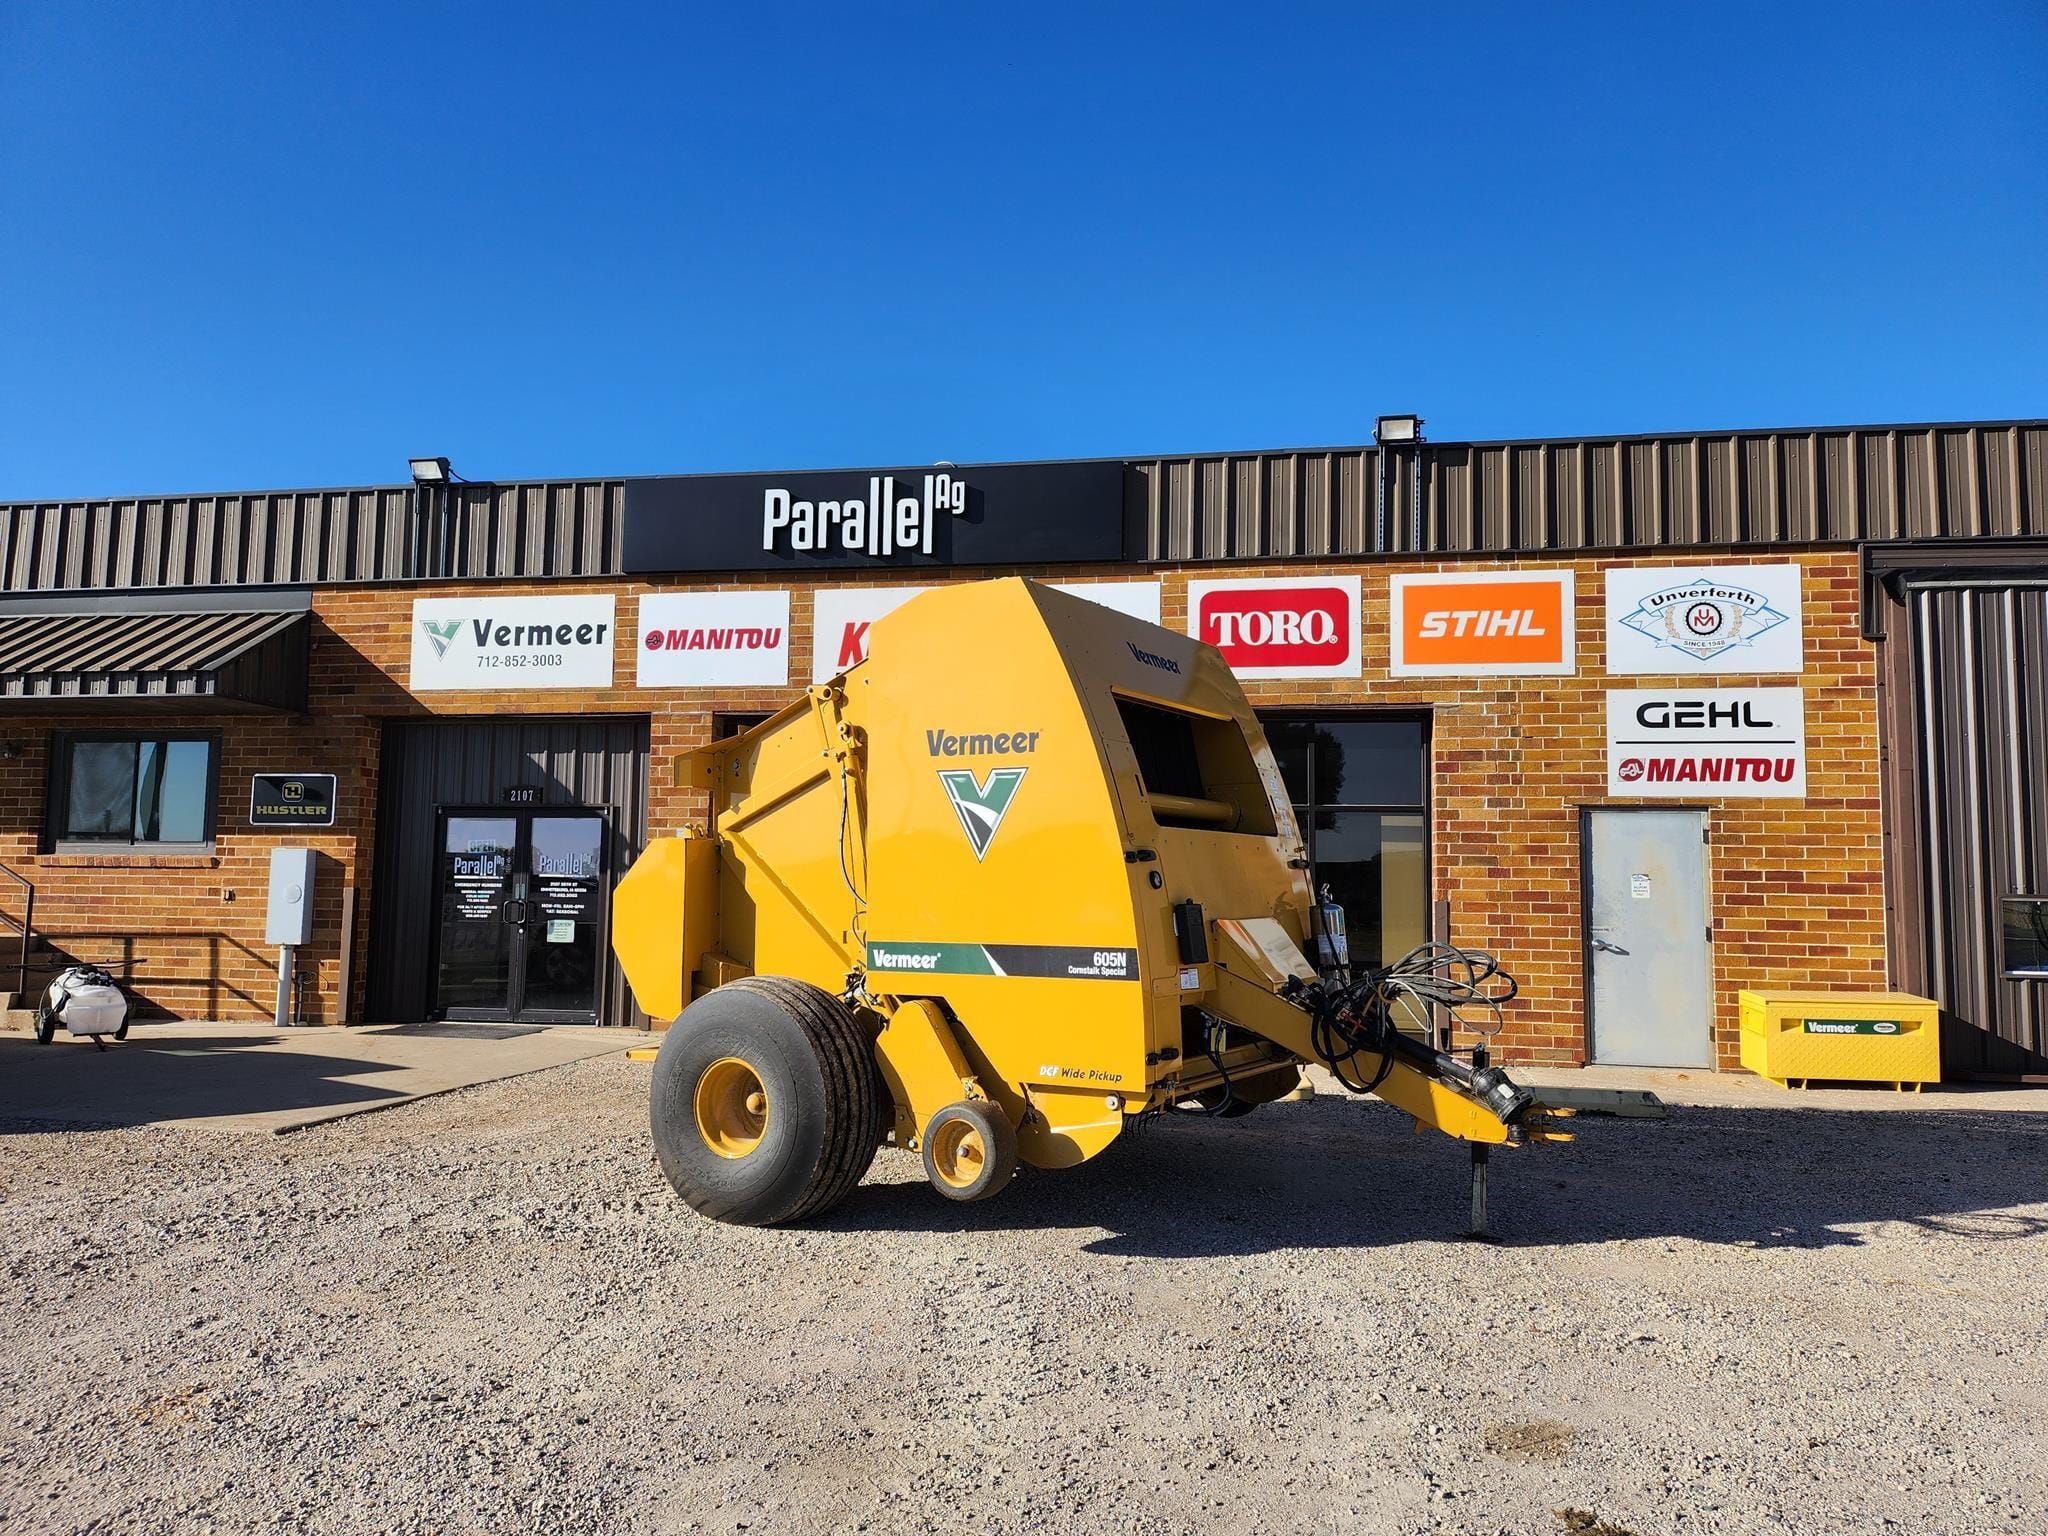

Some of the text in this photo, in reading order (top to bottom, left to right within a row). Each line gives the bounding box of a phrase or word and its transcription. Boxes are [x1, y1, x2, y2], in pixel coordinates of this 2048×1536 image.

[763, 474, 966, 555] Parallel Ag
[1651, 587, 1756, 607] Unverferth
[472, 618, 607, 647] Vermeer
[1210, 609, 1335, 647] TORO
[1418, 609, 1546, 638] STIHL
[665, 628, 782, 651] MANITOU
[1684, 640, 1706, 648] SINCE
[477, 654, 563, 668] 712-852-3003
[1126, 641, 1181, 675] Vermeer
[1636, 700, 1774, 729] GEHL
[926, 729, 1040, 757] Vermeer
[1646, 758, 1796, 783] MANITOU
[511, 790, 534, 801] 2107
[256, 805, 328, 815] HUSTLER
[454, 855, 497, 876] Parallel
[540, 853, 582, 874] Parallel
[873, 949, 938, 969] Vermeer
[1093, 951, 1127, 967] 605N
[1068, 966, 1127, 977] Cornstalk Special
[1808, 1021, 1857, 1034] Vermeer
[1040, 1065, 1122, 1084] DCF Wide Pickup
